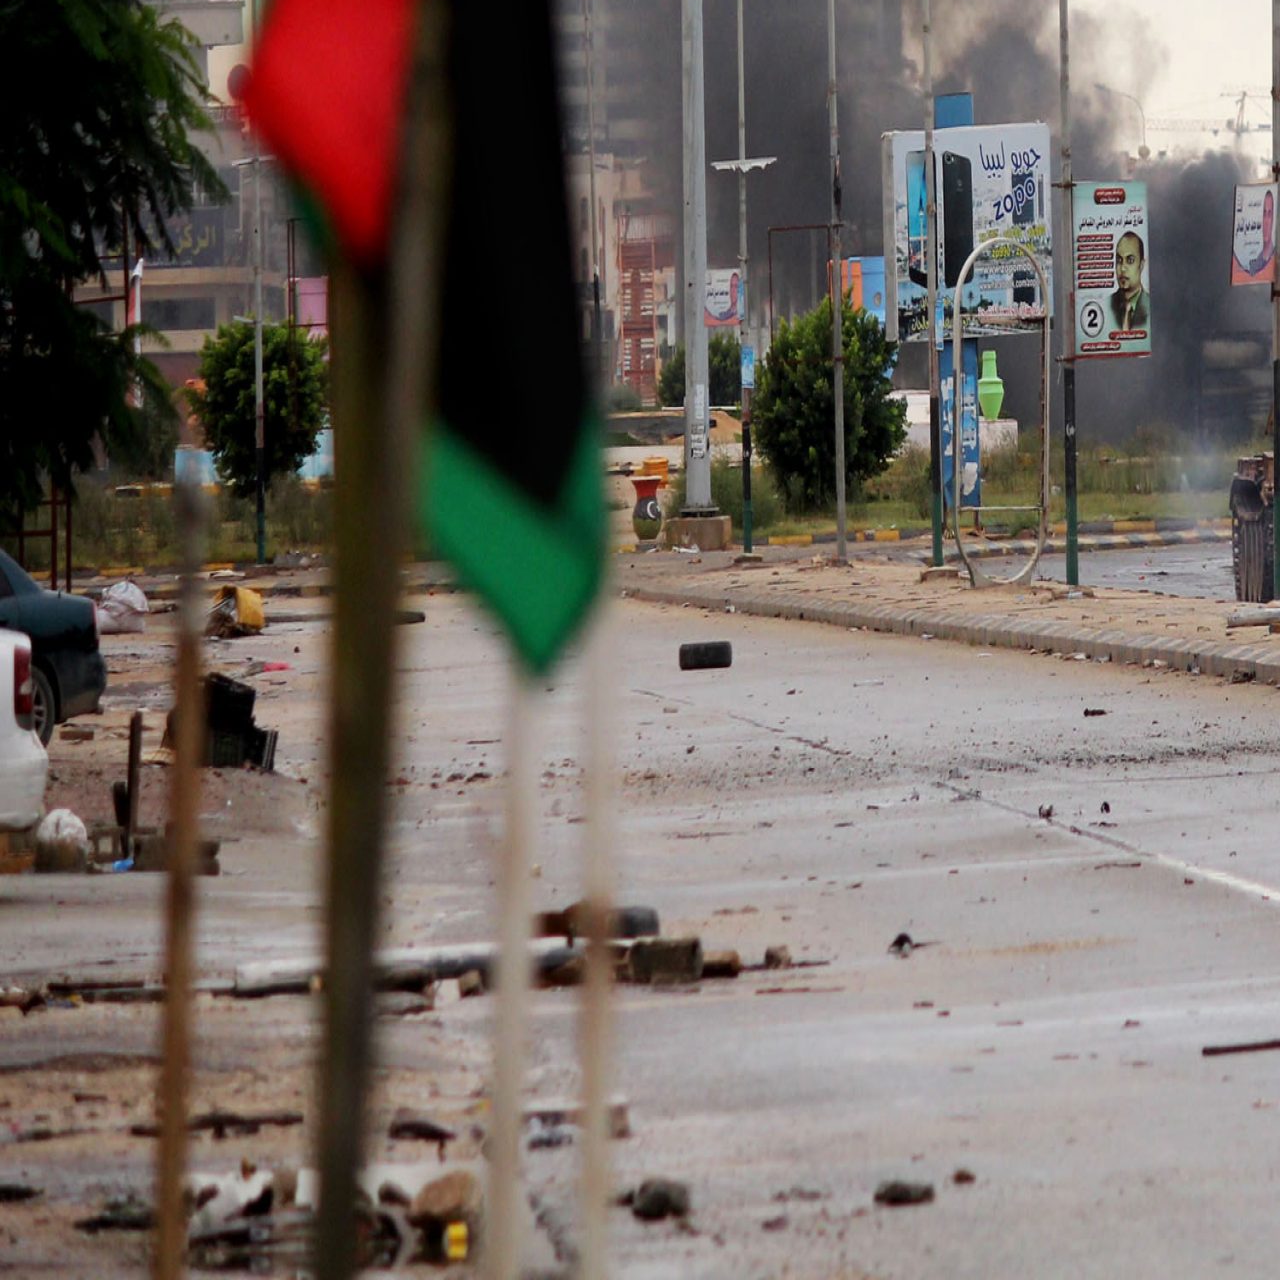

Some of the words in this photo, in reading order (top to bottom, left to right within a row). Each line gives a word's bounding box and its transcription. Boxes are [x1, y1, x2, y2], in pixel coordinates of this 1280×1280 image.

[979, 140, 1005, 179] ليبيا
[993, 179, 1036, 221] zopo
[1087, 309, 1098, 328] 2
